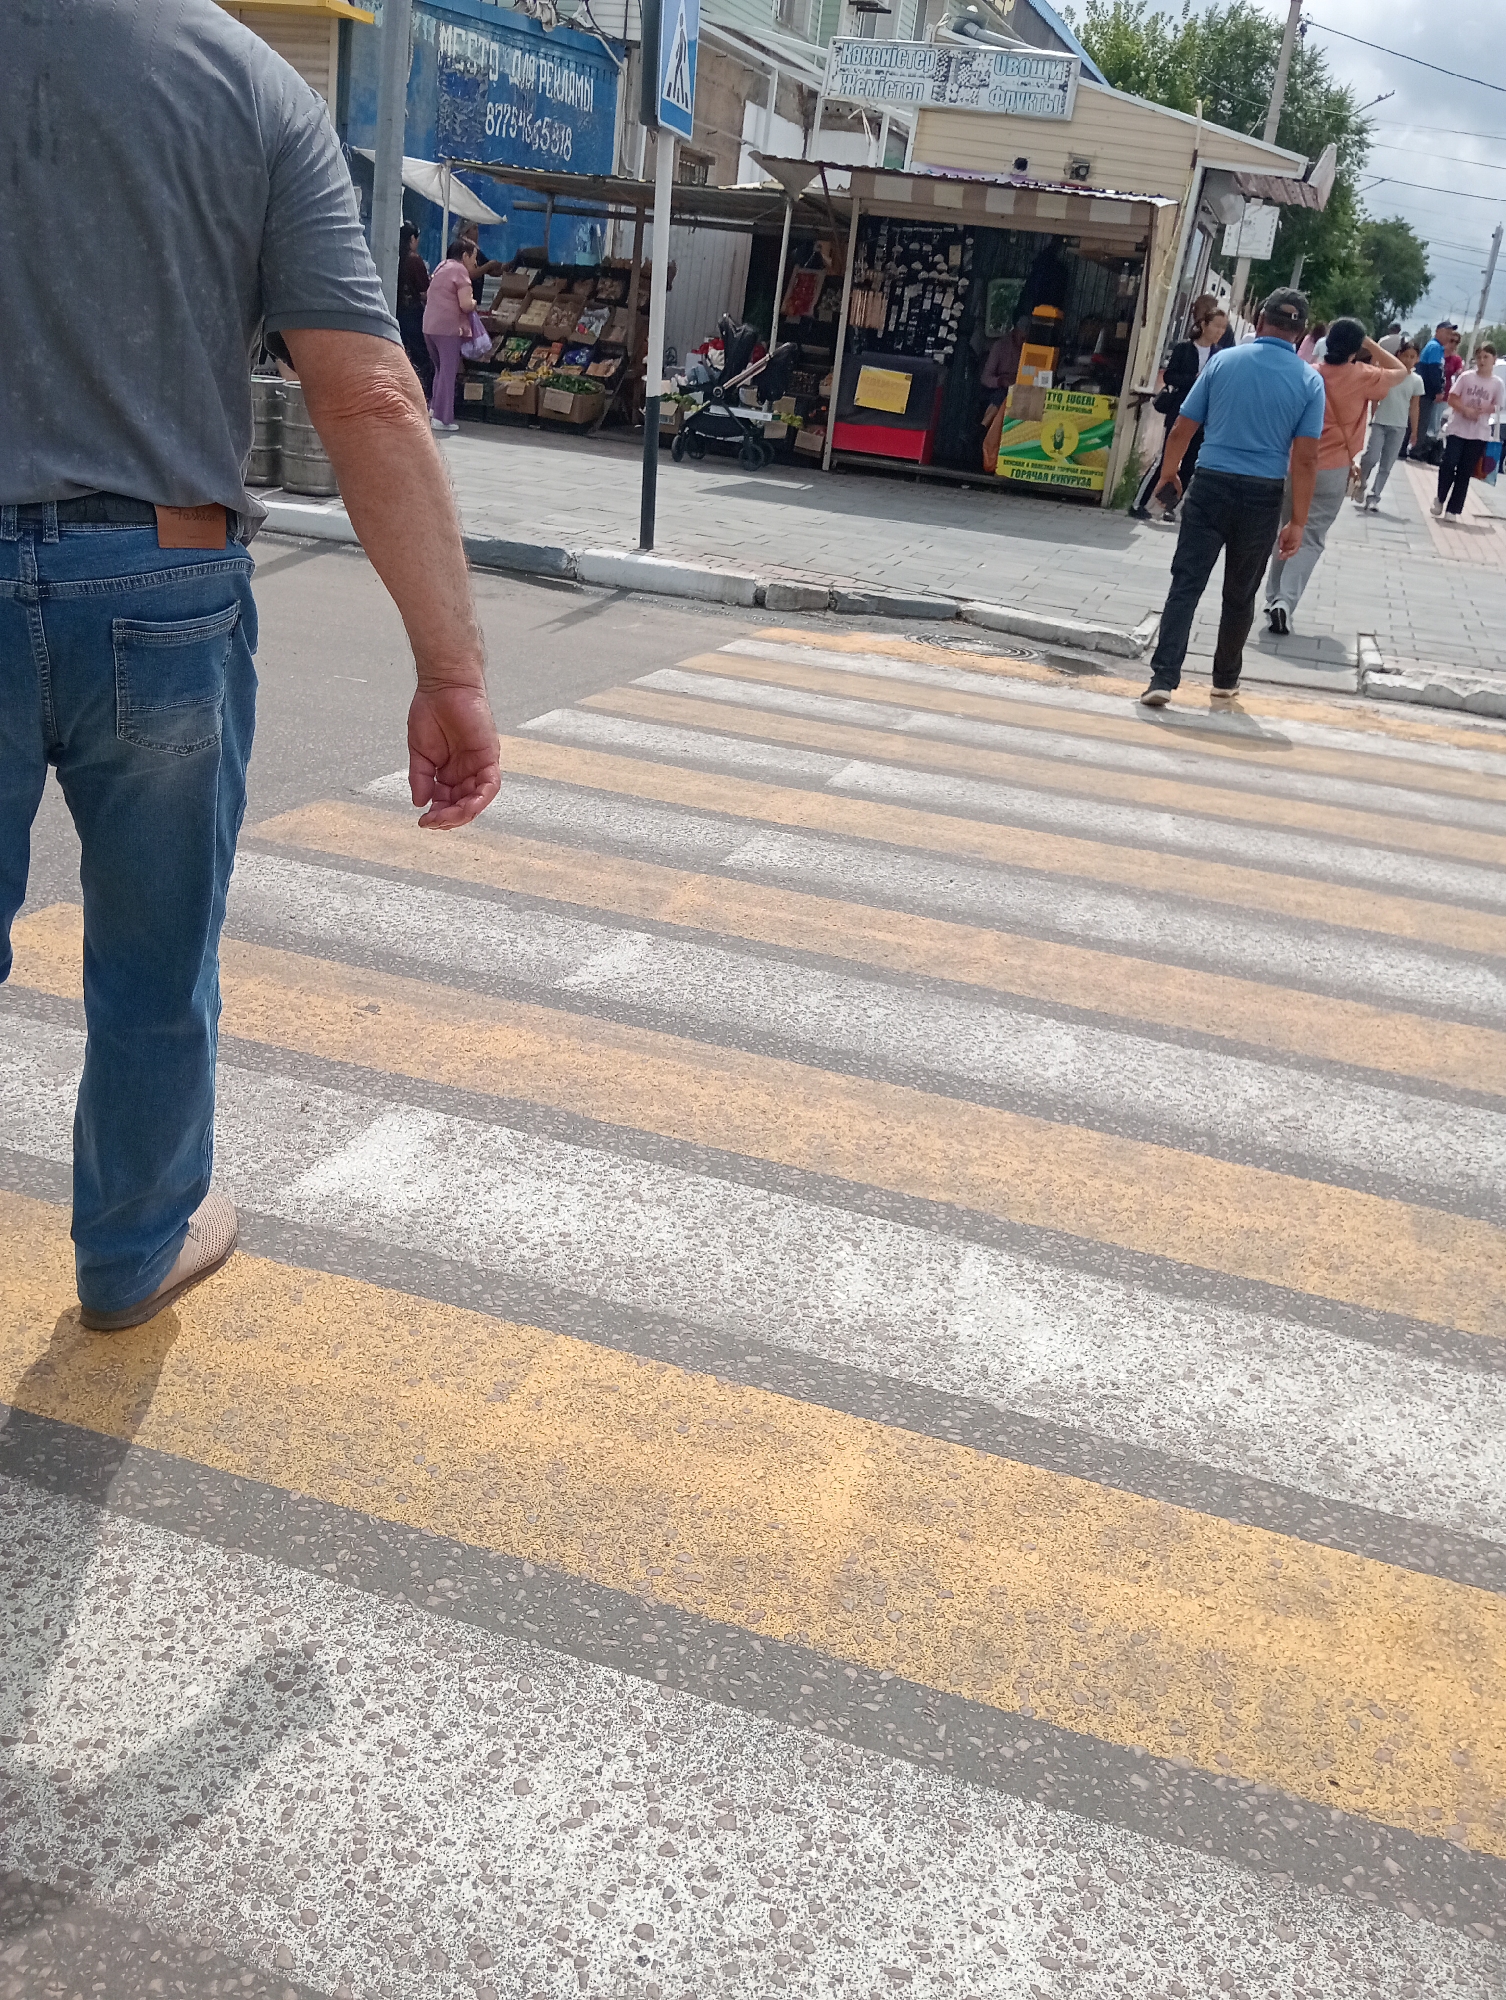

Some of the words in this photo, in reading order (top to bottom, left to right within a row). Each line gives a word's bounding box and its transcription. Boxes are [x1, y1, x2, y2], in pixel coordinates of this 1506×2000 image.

[993, 54, 1065, 82] Овощи
[989, 86, 1062, 113] Фрукты
[1046, 391, 1063, 404] TYQ
[1011, 469, 1049, 481] ГОРЯЧАЯ
[1051, 473, 1092, 487] КУКУРУЗА
